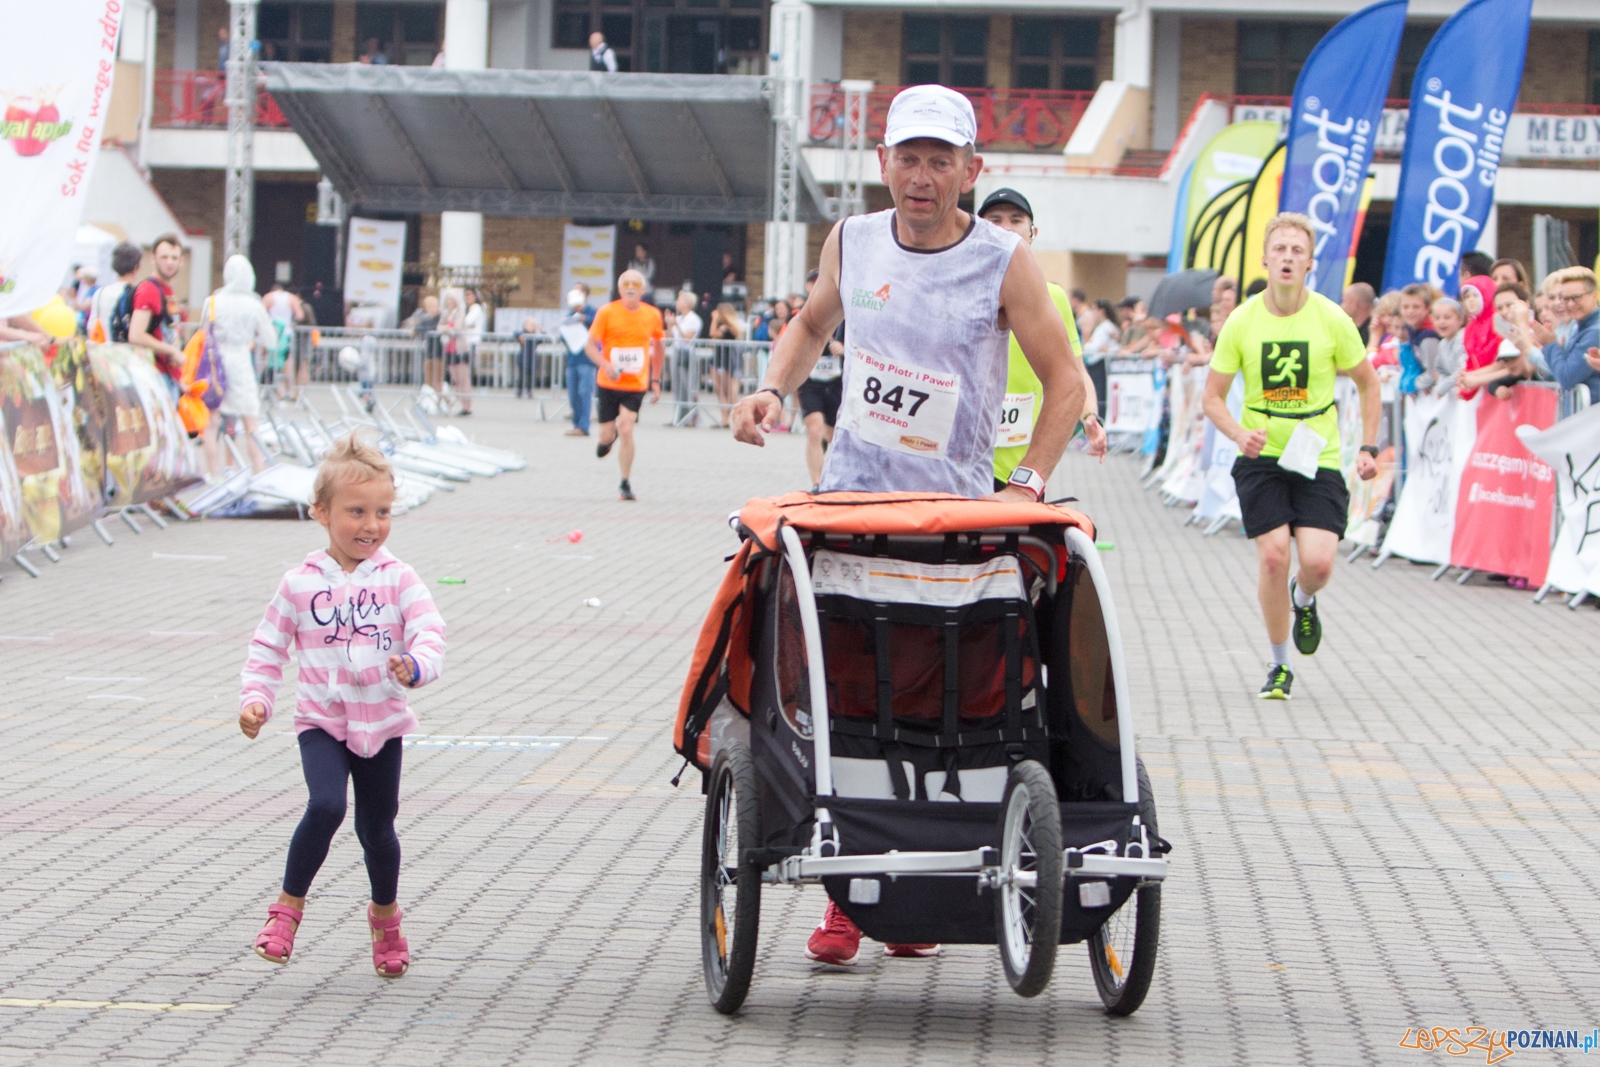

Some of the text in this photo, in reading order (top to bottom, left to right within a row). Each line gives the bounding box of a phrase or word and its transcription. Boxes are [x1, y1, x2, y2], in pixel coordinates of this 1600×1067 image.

[1342, 118, 1371, 195] clinic
[1476, 107, 1507, 187] clinic
[851, 297, 886, 311] FAMILY
[865, 355, 885, 371] Bieg
[887, 363, 914, 378] Piotr
[915, 372, 920, 380] i
[863, 376, 930, 417] 847
[869, 410, 909, 428] RYSZARD
